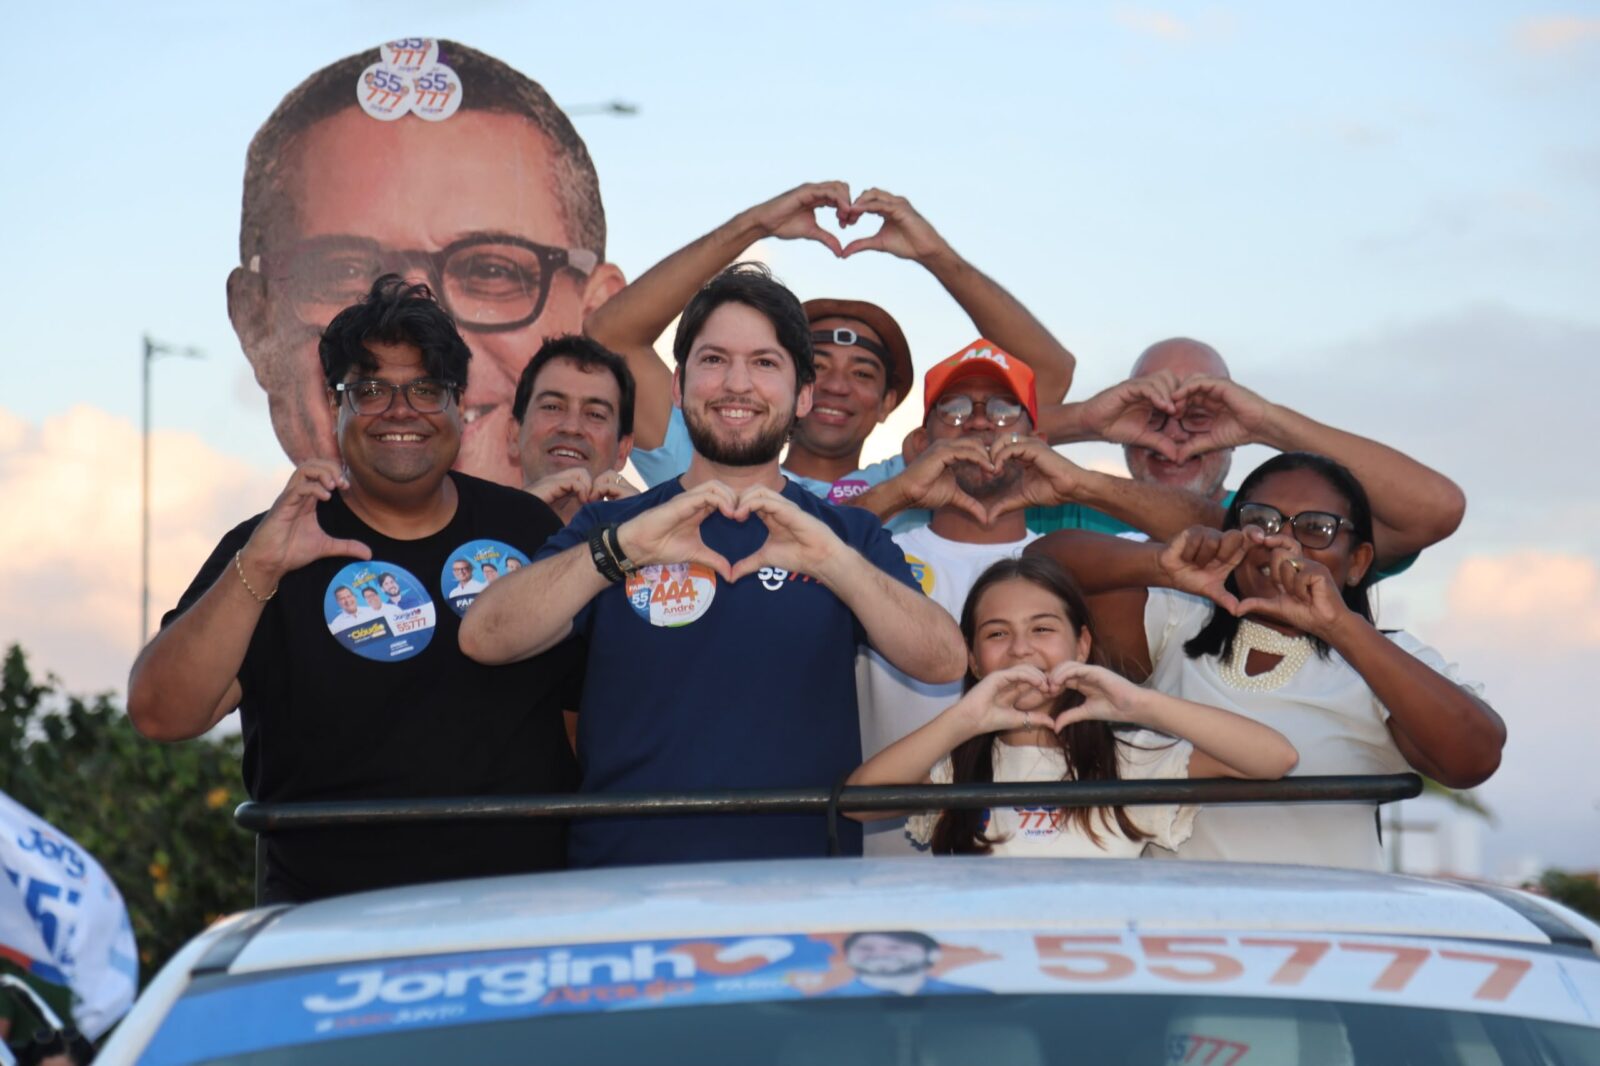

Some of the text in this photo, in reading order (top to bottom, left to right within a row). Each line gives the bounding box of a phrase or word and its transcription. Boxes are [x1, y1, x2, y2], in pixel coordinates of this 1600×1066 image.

[391, 49, 427, 65] 777
[373, 70, 403, 92] 55
[419, 73, 448, 91] 55
[366, 86, 404, 108] 777
[415, 90, 450, 108] 777
[631, 592, 649, 604] 55
[1034, 935, 1534, 1002] 55777
